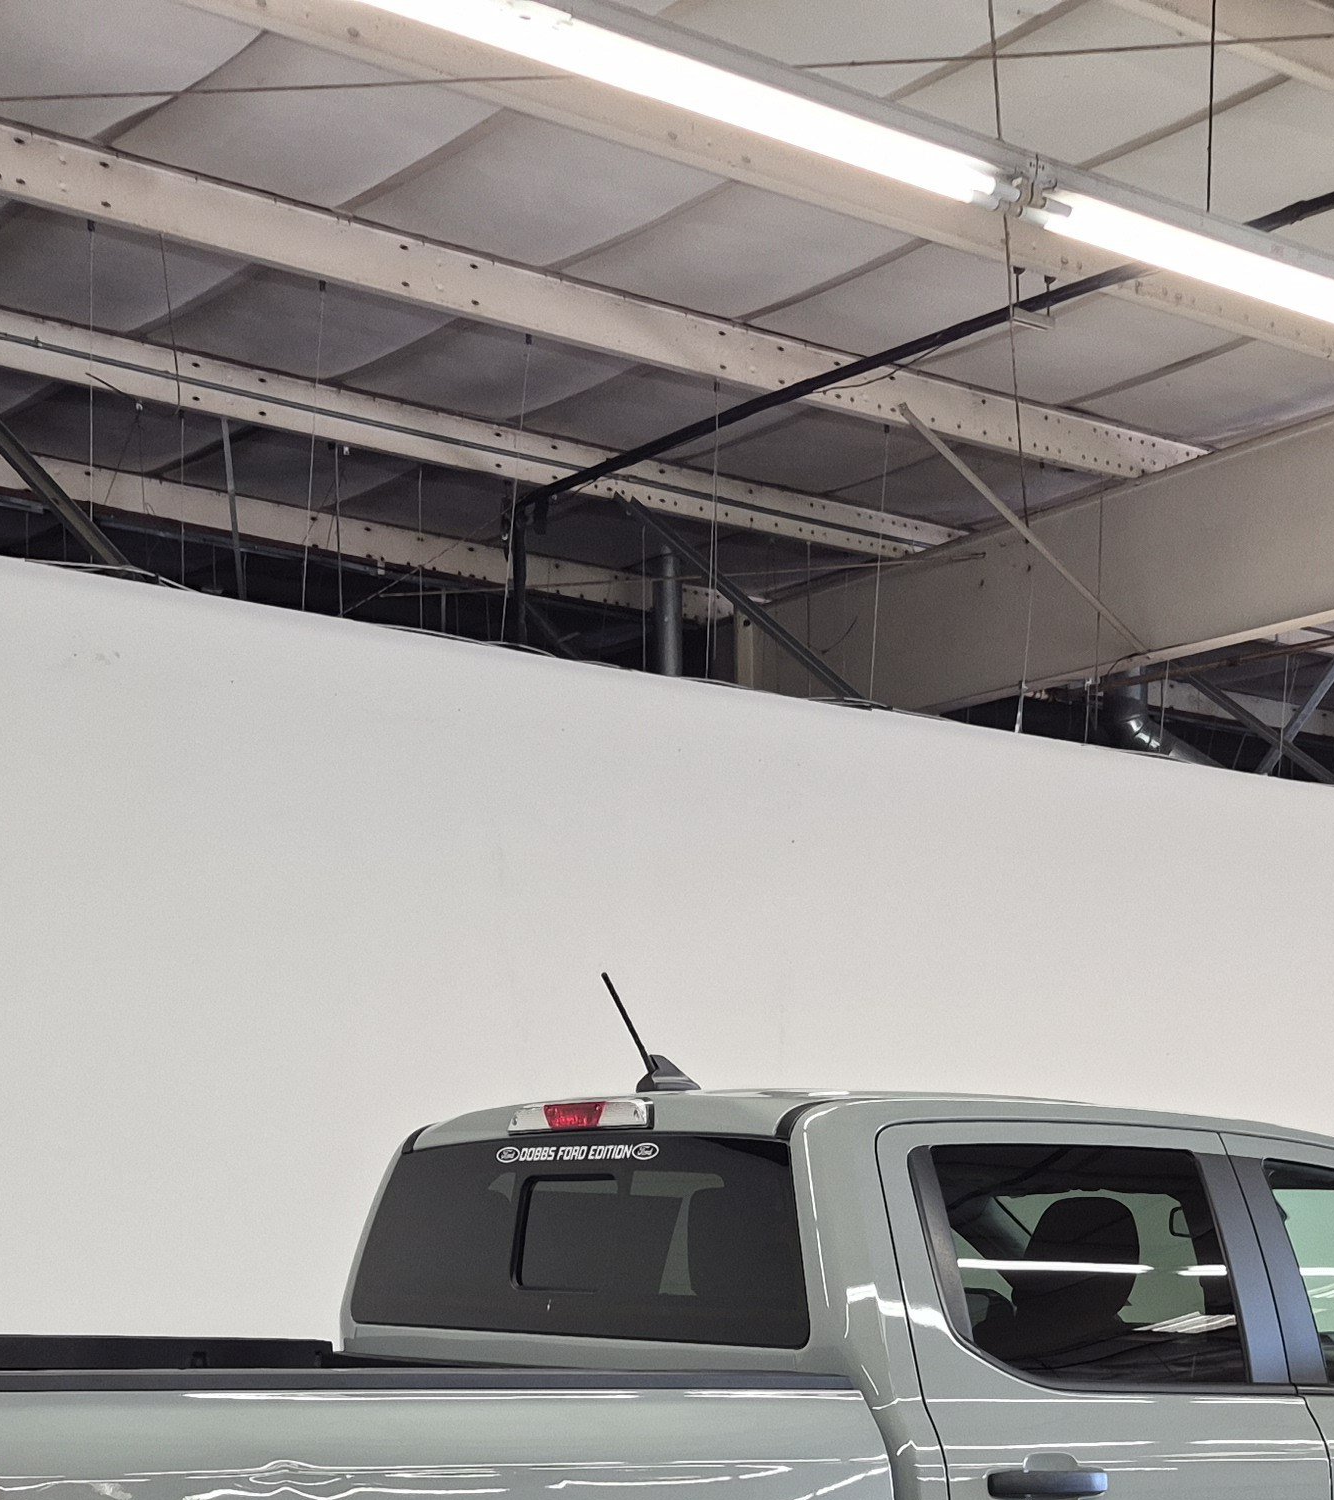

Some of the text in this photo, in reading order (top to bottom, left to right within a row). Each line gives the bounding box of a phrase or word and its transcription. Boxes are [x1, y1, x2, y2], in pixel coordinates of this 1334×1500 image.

[519, 1147, 555, 1162] DOBBS
[556, 1146, 586, 1161] FORD
[588, 1144, 633, 1160] EDITION
